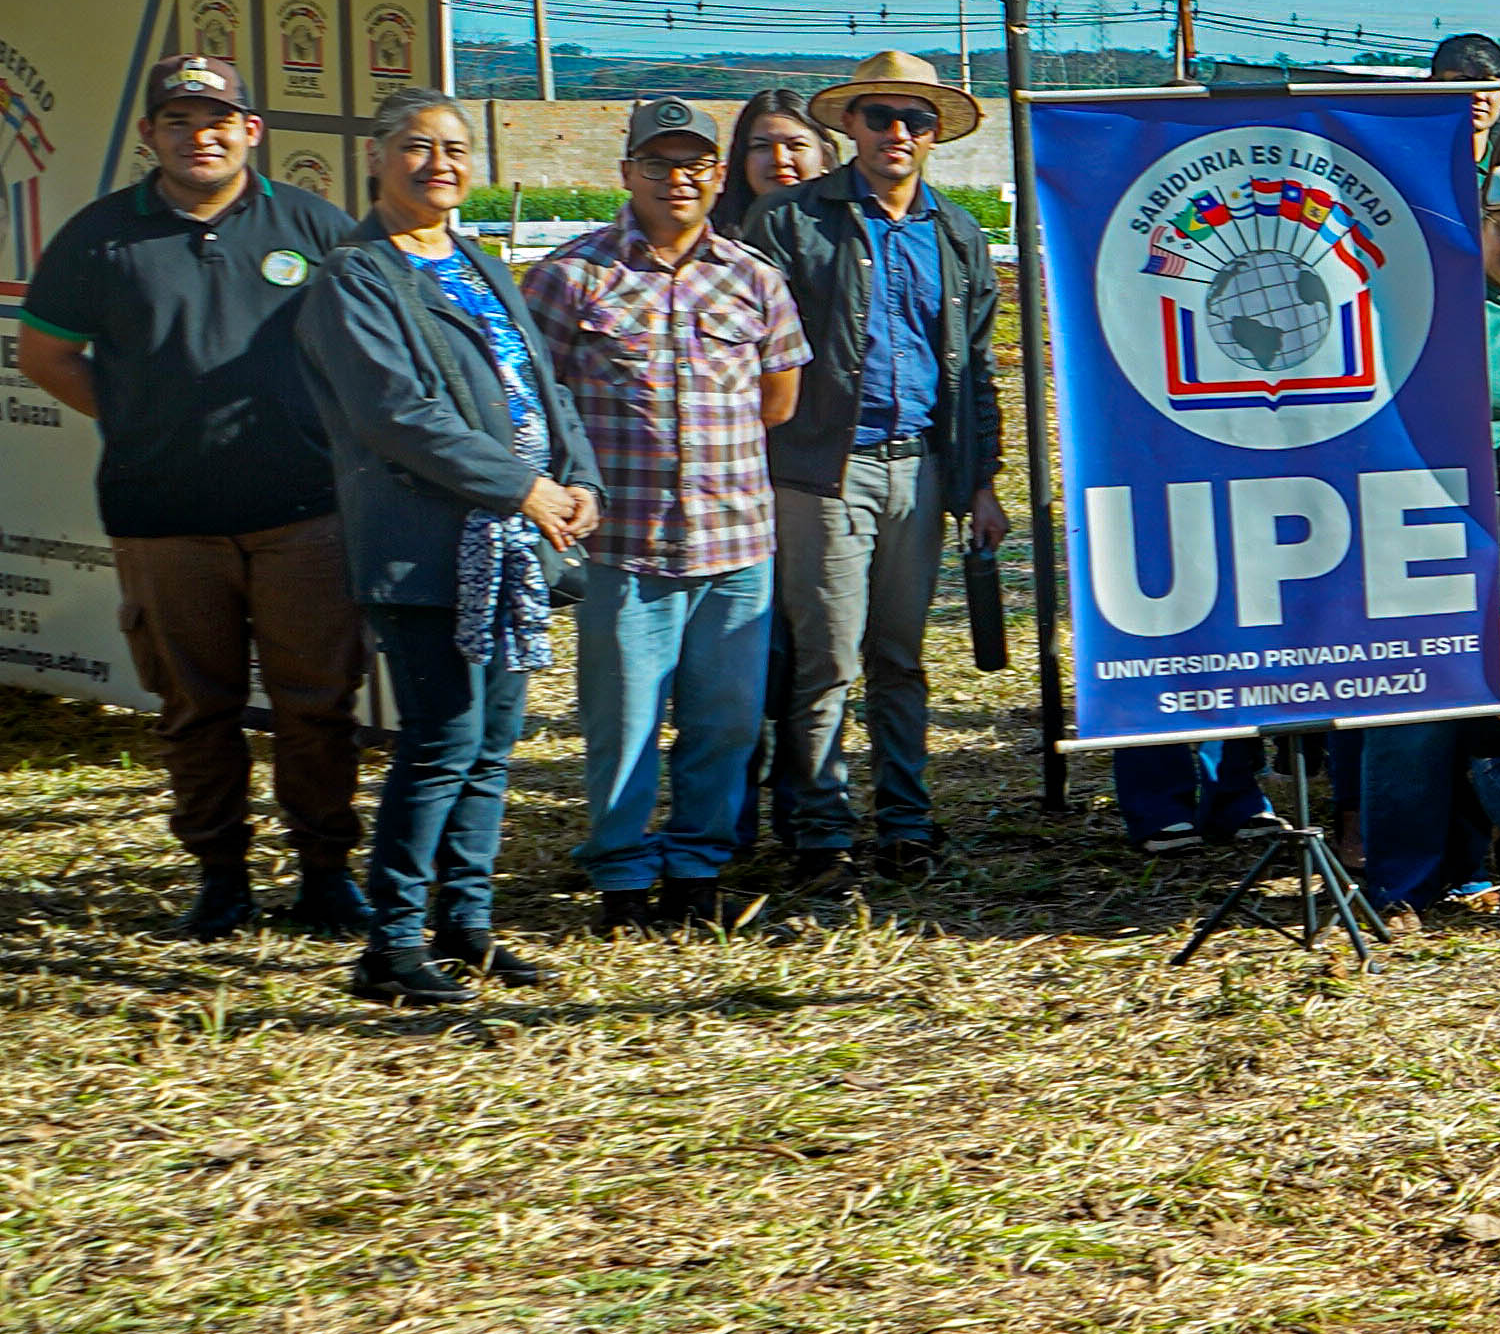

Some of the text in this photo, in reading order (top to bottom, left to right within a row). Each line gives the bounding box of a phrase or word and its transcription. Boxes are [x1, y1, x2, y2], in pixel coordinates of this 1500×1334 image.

[1131, 145, 1392, 235] SABIDURIA ES LIBERTAD
[1085, 467, 1478, 637] UPE
[1097, 634, 1480, 680] UNIVERSIDAD PRIVADA DEL ESTE
[1159, 668, 1427, 714] SEDE MINGA GUAZÚ
